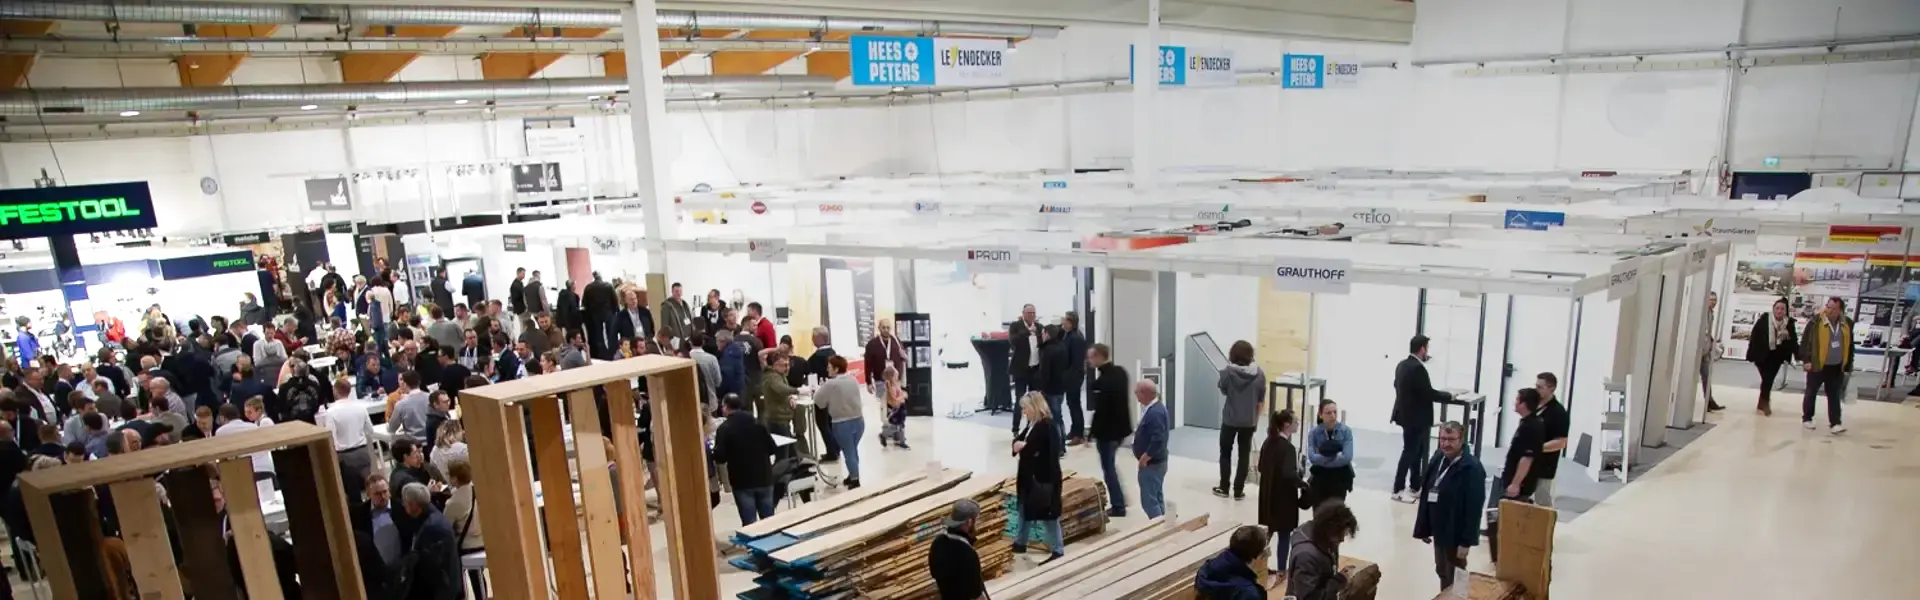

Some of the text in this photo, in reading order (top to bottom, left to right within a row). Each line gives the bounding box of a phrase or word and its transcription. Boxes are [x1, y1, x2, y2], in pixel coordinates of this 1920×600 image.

[868, 41, 902, 61] HEES
[941, 44, 1002, 68] LEYENDECKER
[869, 62, 920, 82] PETERS
[0, 197, 140, 225] FESTOOL
[213, 257, 250, 268] FESTOOL
[1276, 266, 1345, 280] GRAUTHOFF
